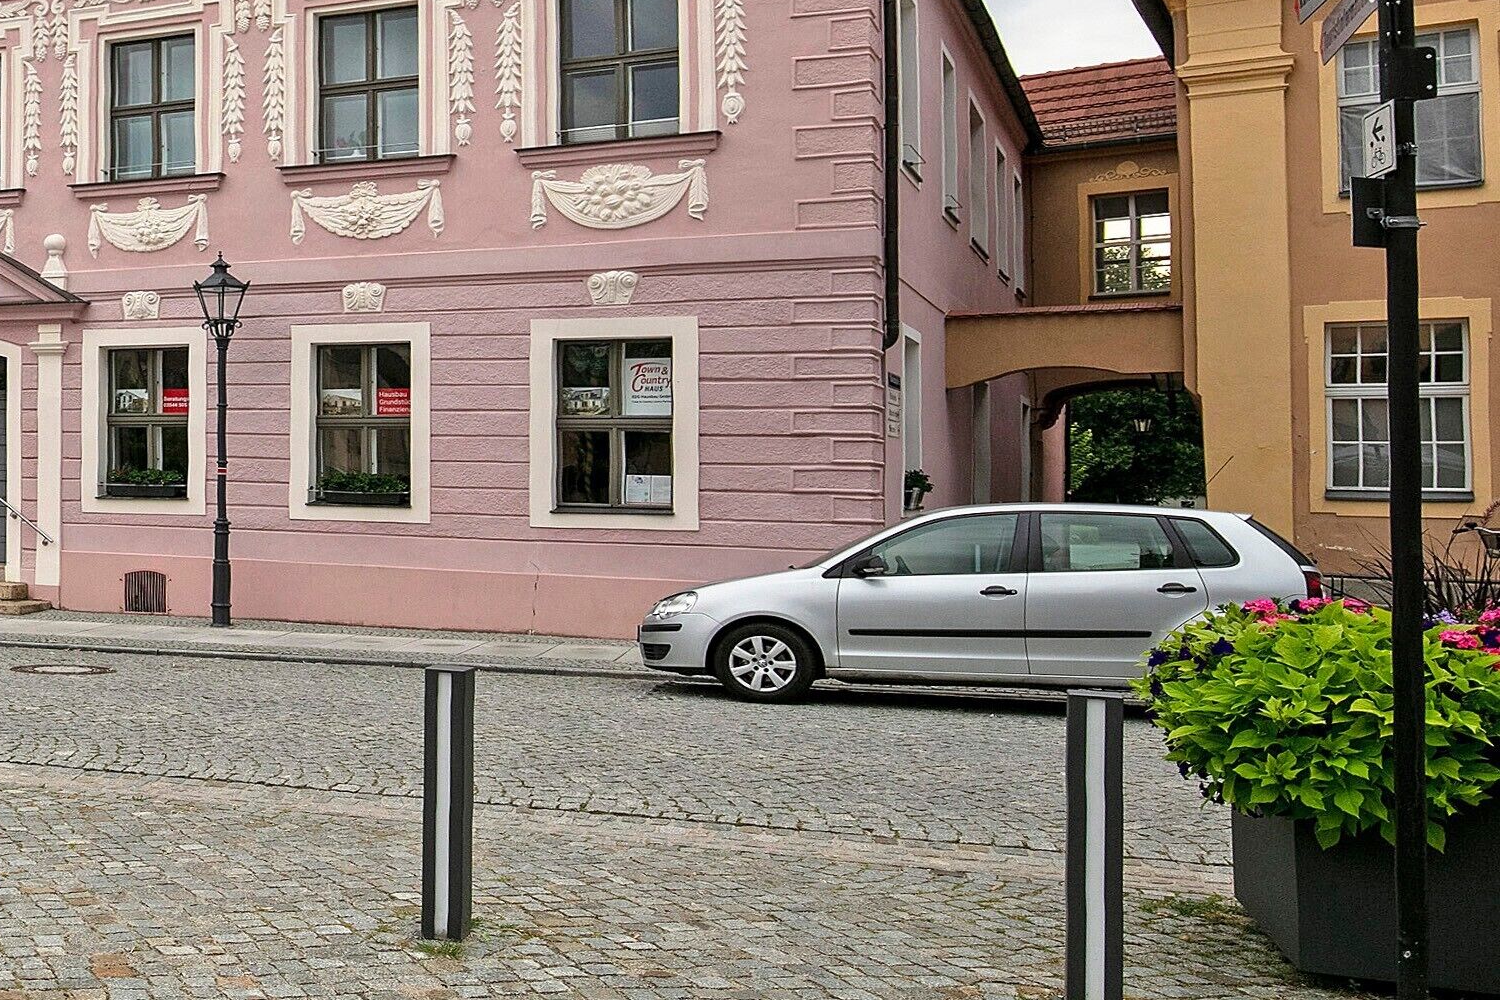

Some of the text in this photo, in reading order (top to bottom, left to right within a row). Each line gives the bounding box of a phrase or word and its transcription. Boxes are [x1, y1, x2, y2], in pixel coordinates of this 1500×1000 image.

[630, 361, 668, 376] Town &
[631, 374, 671, 392] Country
